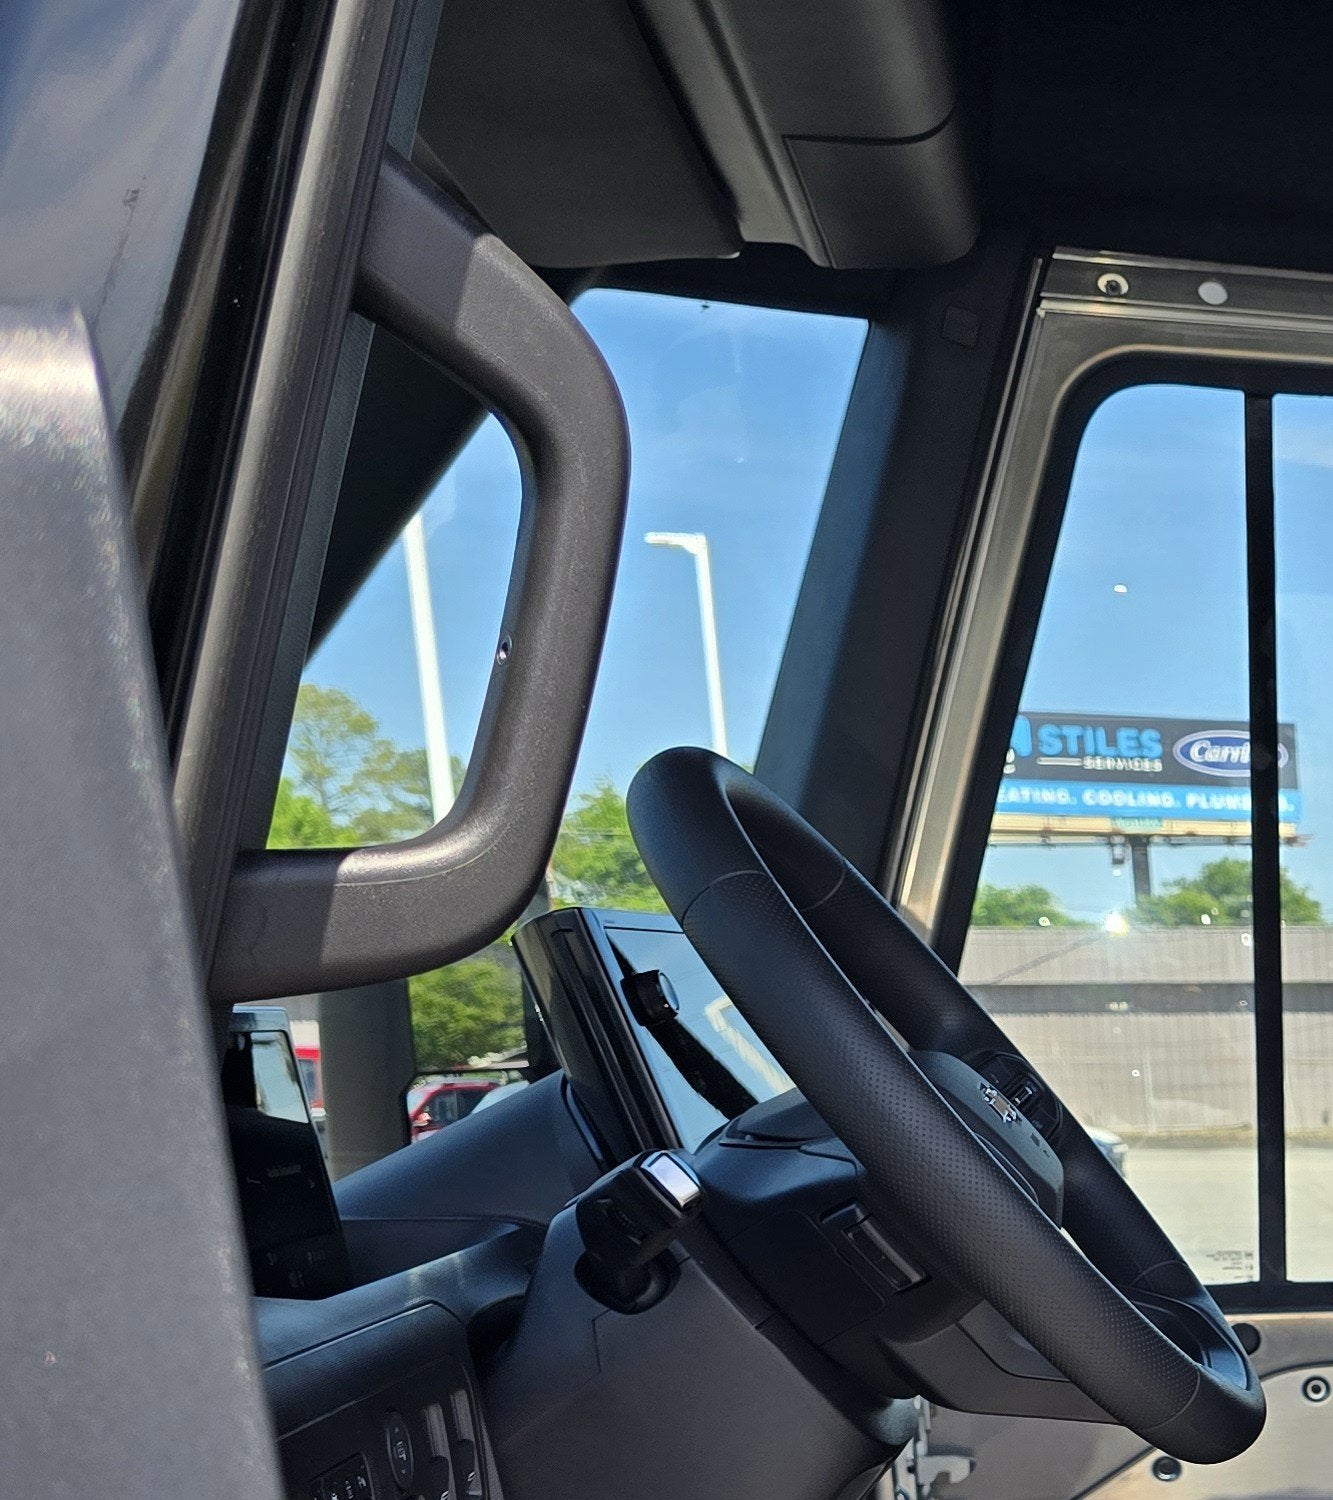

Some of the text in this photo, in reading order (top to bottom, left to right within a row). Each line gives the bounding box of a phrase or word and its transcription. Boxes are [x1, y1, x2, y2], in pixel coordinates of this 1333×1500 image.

[1037, 724, 1163, 758] STILES
[1189, 739, 1251, 763] Carri
[1083, 756, 1163, 772] SERVICES
[998, 786, 1077, 806] EATING.
[1186, 791, 1294, 814] PLUMBG.
